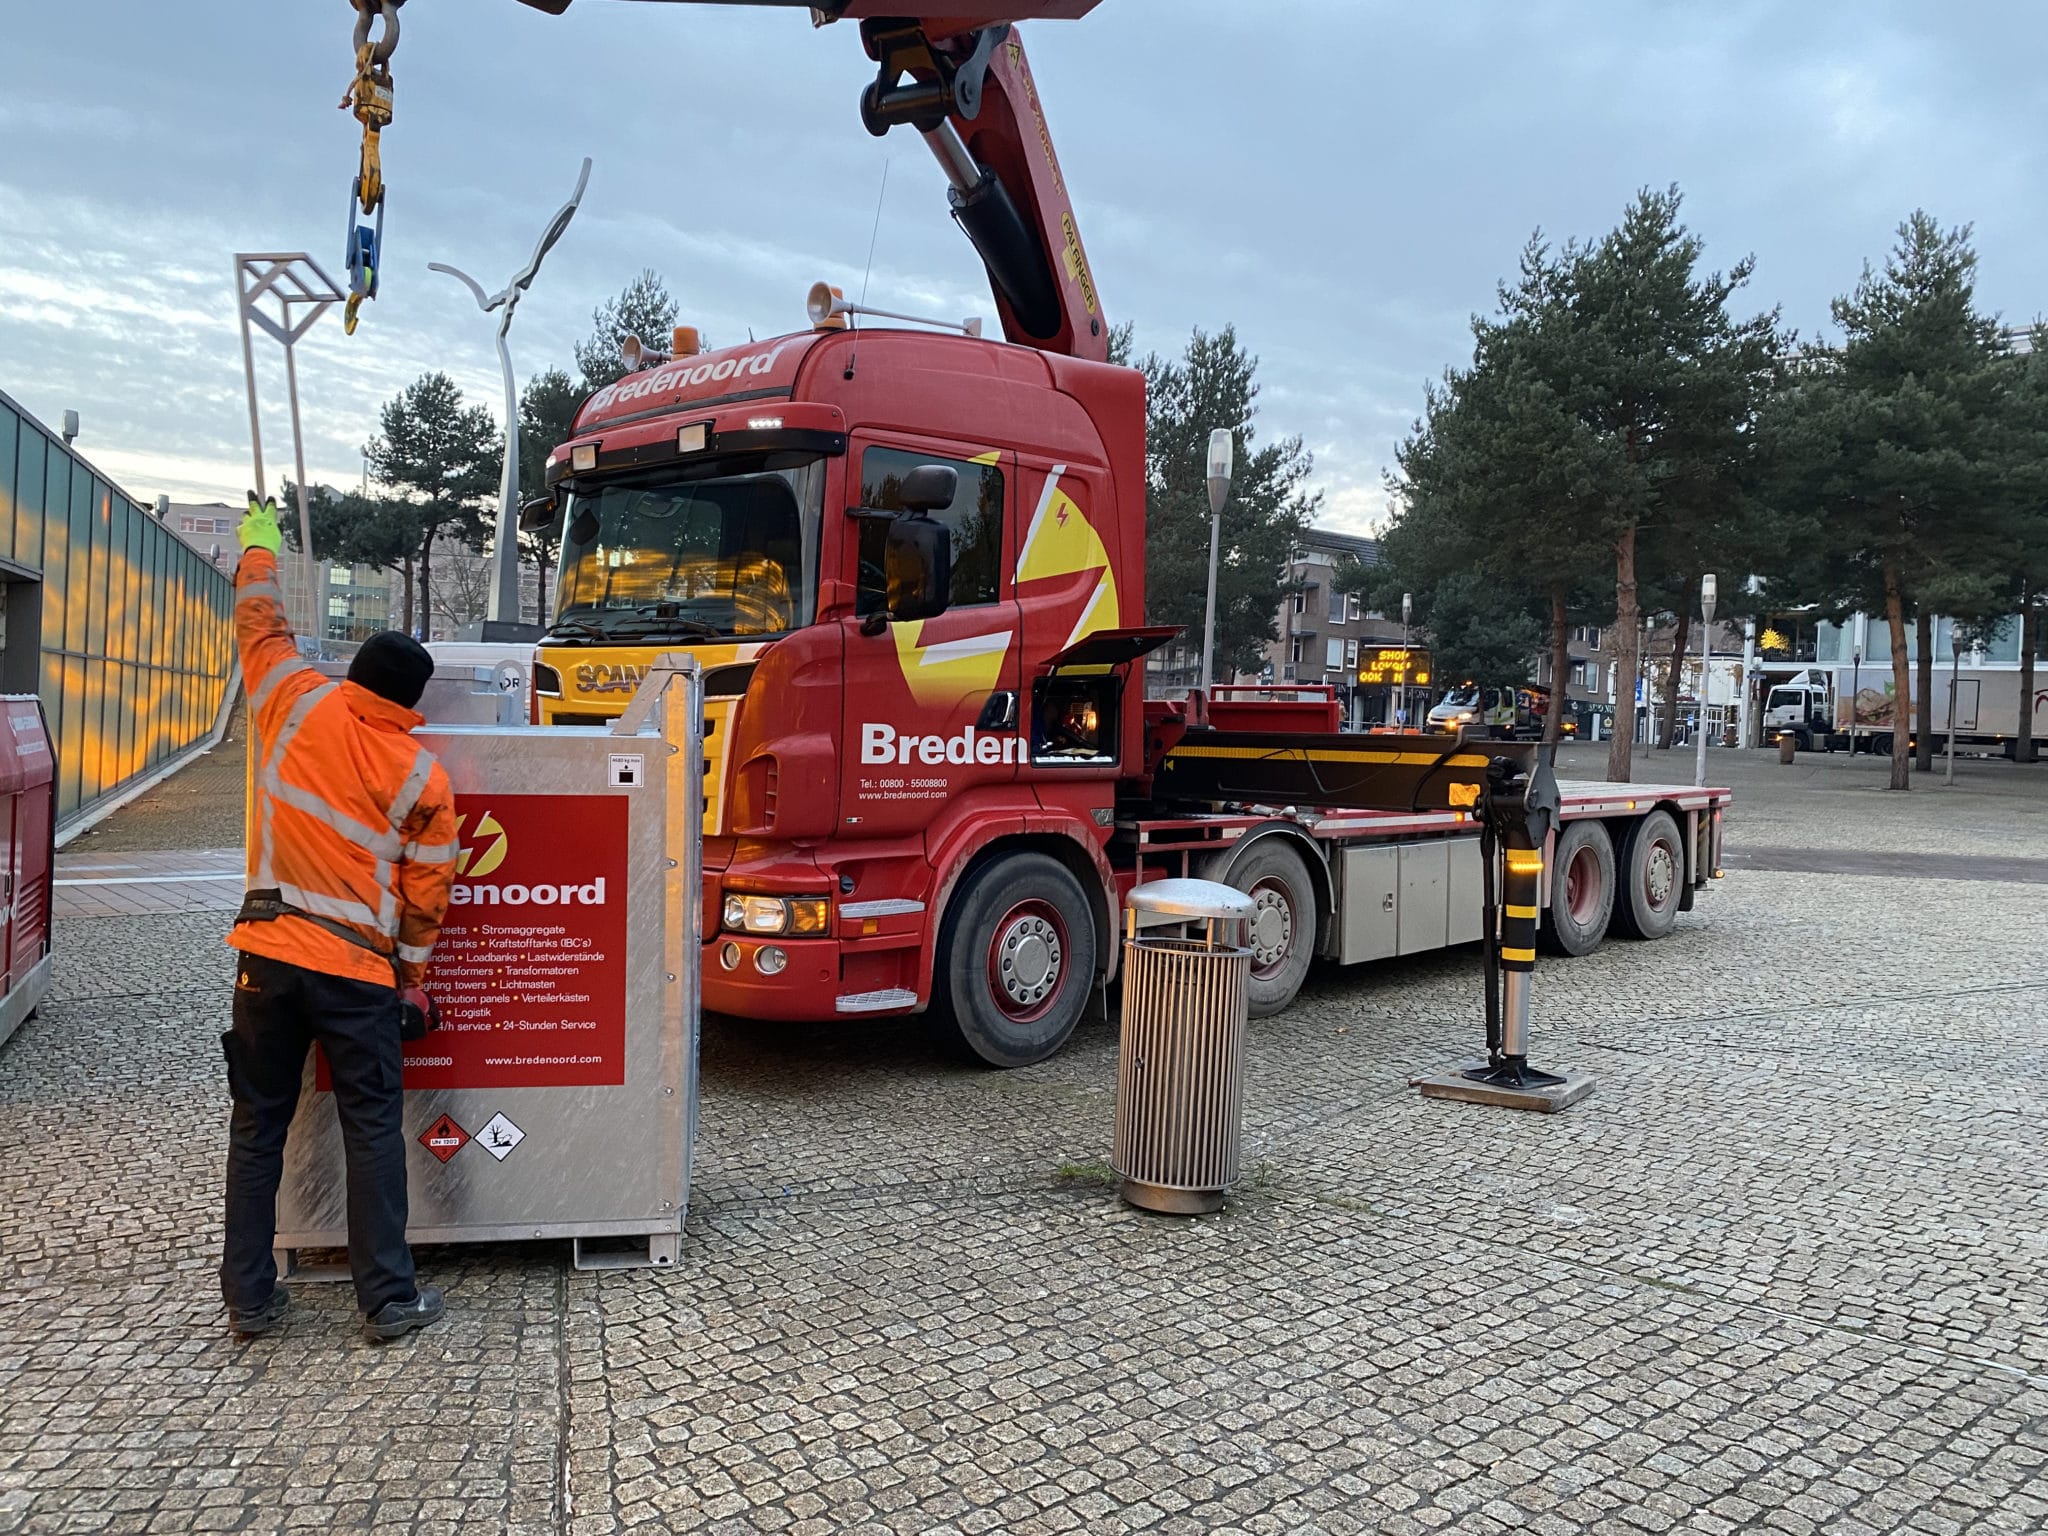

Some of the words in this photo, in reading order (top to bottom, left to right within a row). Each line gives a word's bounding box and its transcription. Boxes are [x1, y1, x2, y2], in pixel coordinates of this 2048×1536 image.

[1063, 217, 1094, 309] PALFINGER
[590, 346, 784, 413] Bredenoord
[576, 664, 653, 693] SCAN
[860, 779, 878, 789] Tel.:
[879, 779, 904, 788] 00800
[910, 779, 947, 788] 55008800
[858, 790, 947, 800] www.bredenoord.com
[449, 877, 606, 905] enoord
[441, 926, 467, 935] nsets
[482, 925, 566, 937] Stromaggregate
[434, 939, 449, 949] uel
[452, 940, 478, 949] tanks
[489, 938, 558, 948] Kraftstofftanks
[429, 953, 455, 962] nden
[466, 953, 518, 962] Loadbanks
[527, 952, 605, 961] Lastwiderstände
[434, 966, 494, 976] Transformers
[505, 965, 579, 975] Transformatoren
[422, 980, 452, 992] ghting
[455, 981, 487, 990] towers
[499, 979, 556, 989] Lichtmasten
[432, 994, 477, 1004] stribution
[480, 994, 511, 1004] panels
[521, 993, 590, 1003] Verteilerkästen
[454, 1007, 491, 1019] Logistik
[457, 1022, 492, 1031] service
[503, 1020, 558, 1031] 24-Stunden
[561, 1018, 597, 1030] Service
[403, 1056, 453, 1067] 55008800
[485, 1055, 602, 1066] www.bredenoord.com
